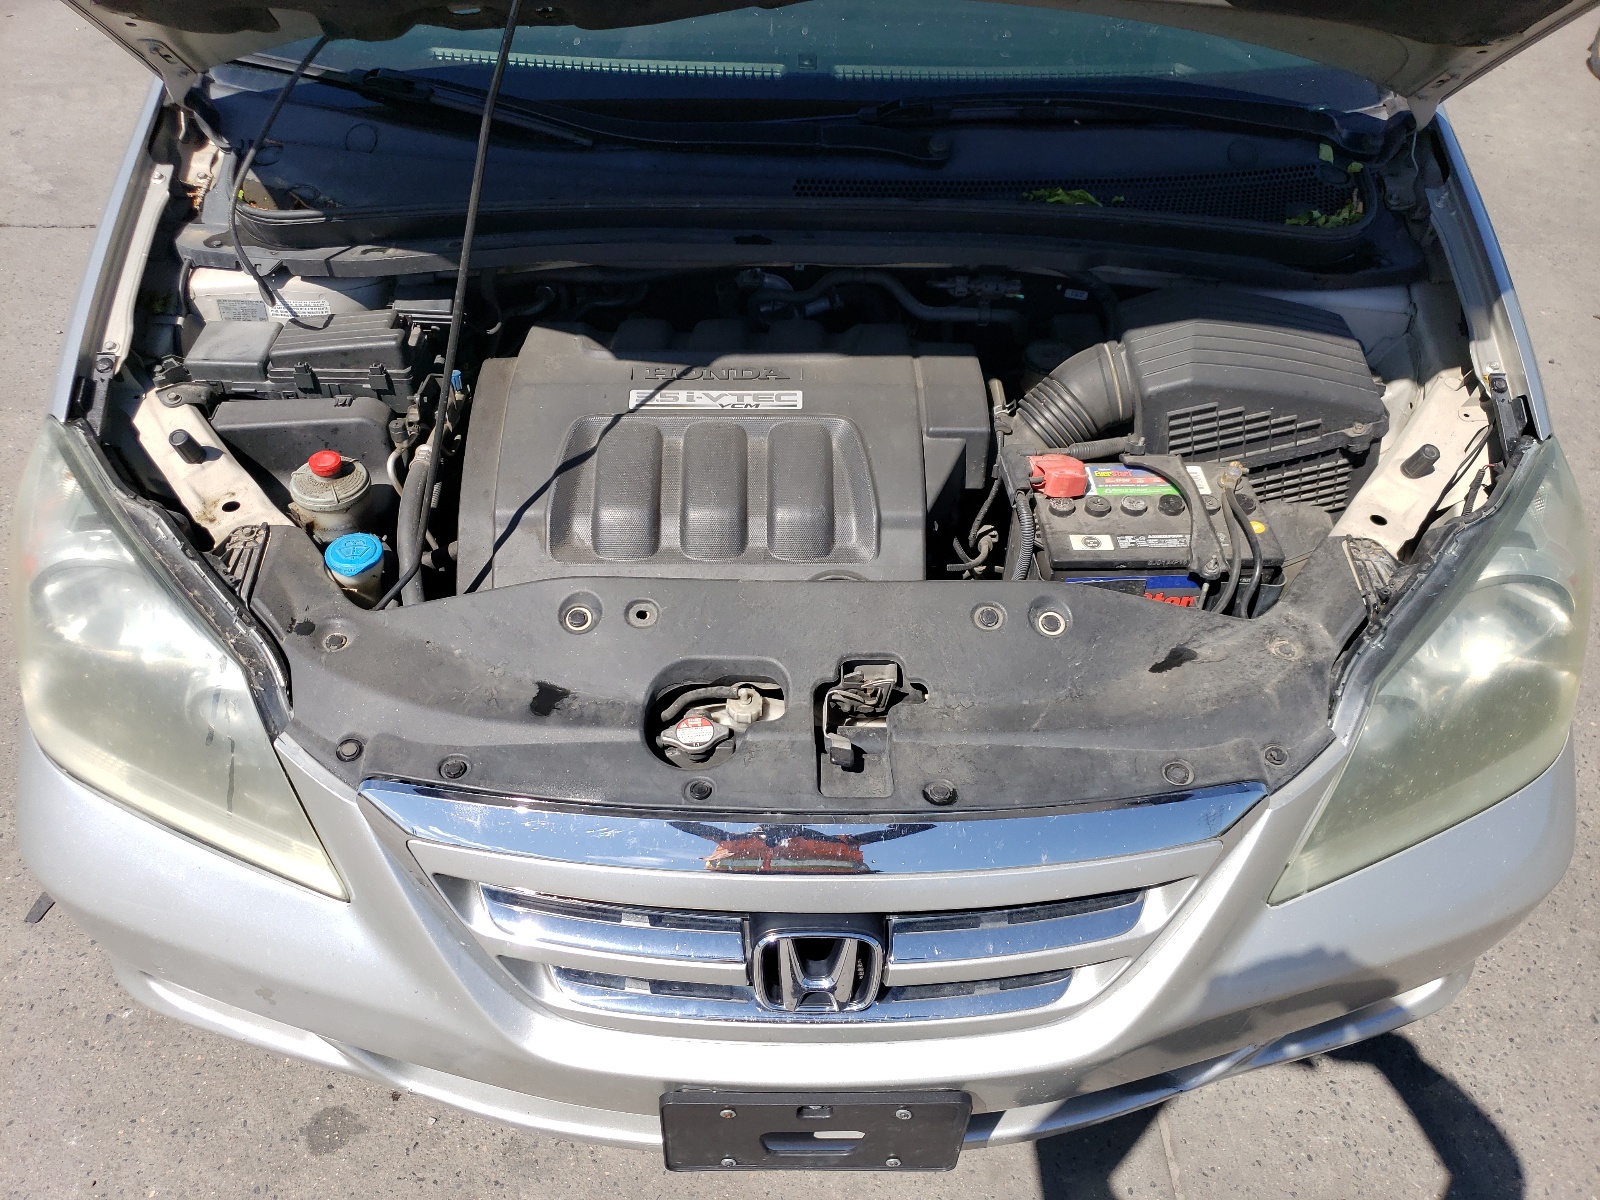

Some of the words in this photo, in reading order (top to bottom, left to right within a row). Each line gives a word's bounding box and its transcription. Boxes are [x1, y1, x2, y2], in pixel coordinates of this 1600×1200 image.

[645, 366, 790, 381] HONDA
[635, 391, 680, 403] 3.5
[1094, 469, 1133, 477] EverStart
